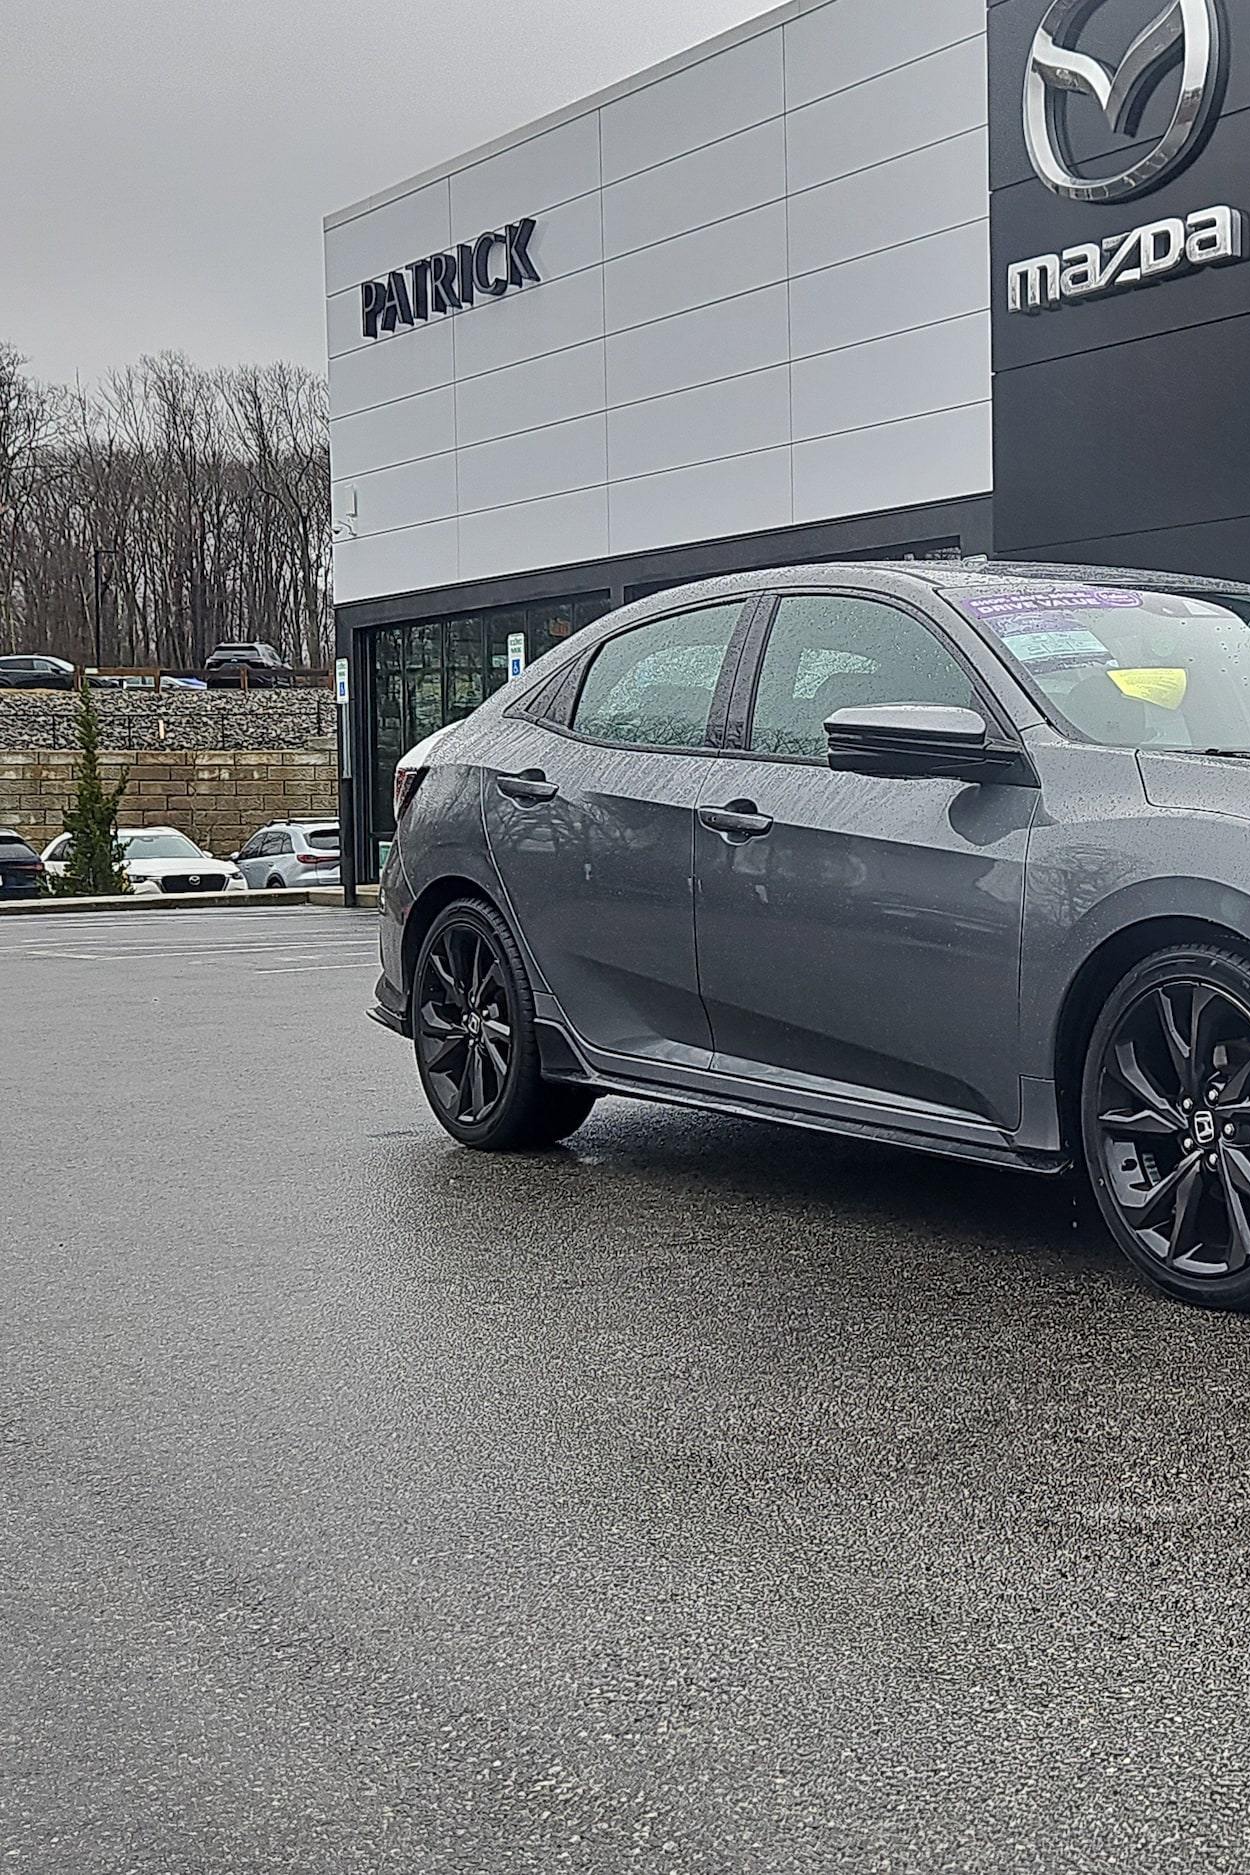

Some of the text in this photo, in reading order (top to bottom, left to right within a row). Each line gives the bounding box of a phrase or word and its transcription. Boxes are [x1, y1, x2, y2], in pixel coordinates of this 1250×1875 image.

[361, 217, 541, 339] PATRICK
[977, 598, 1101, 613] DRIVE VALUE
